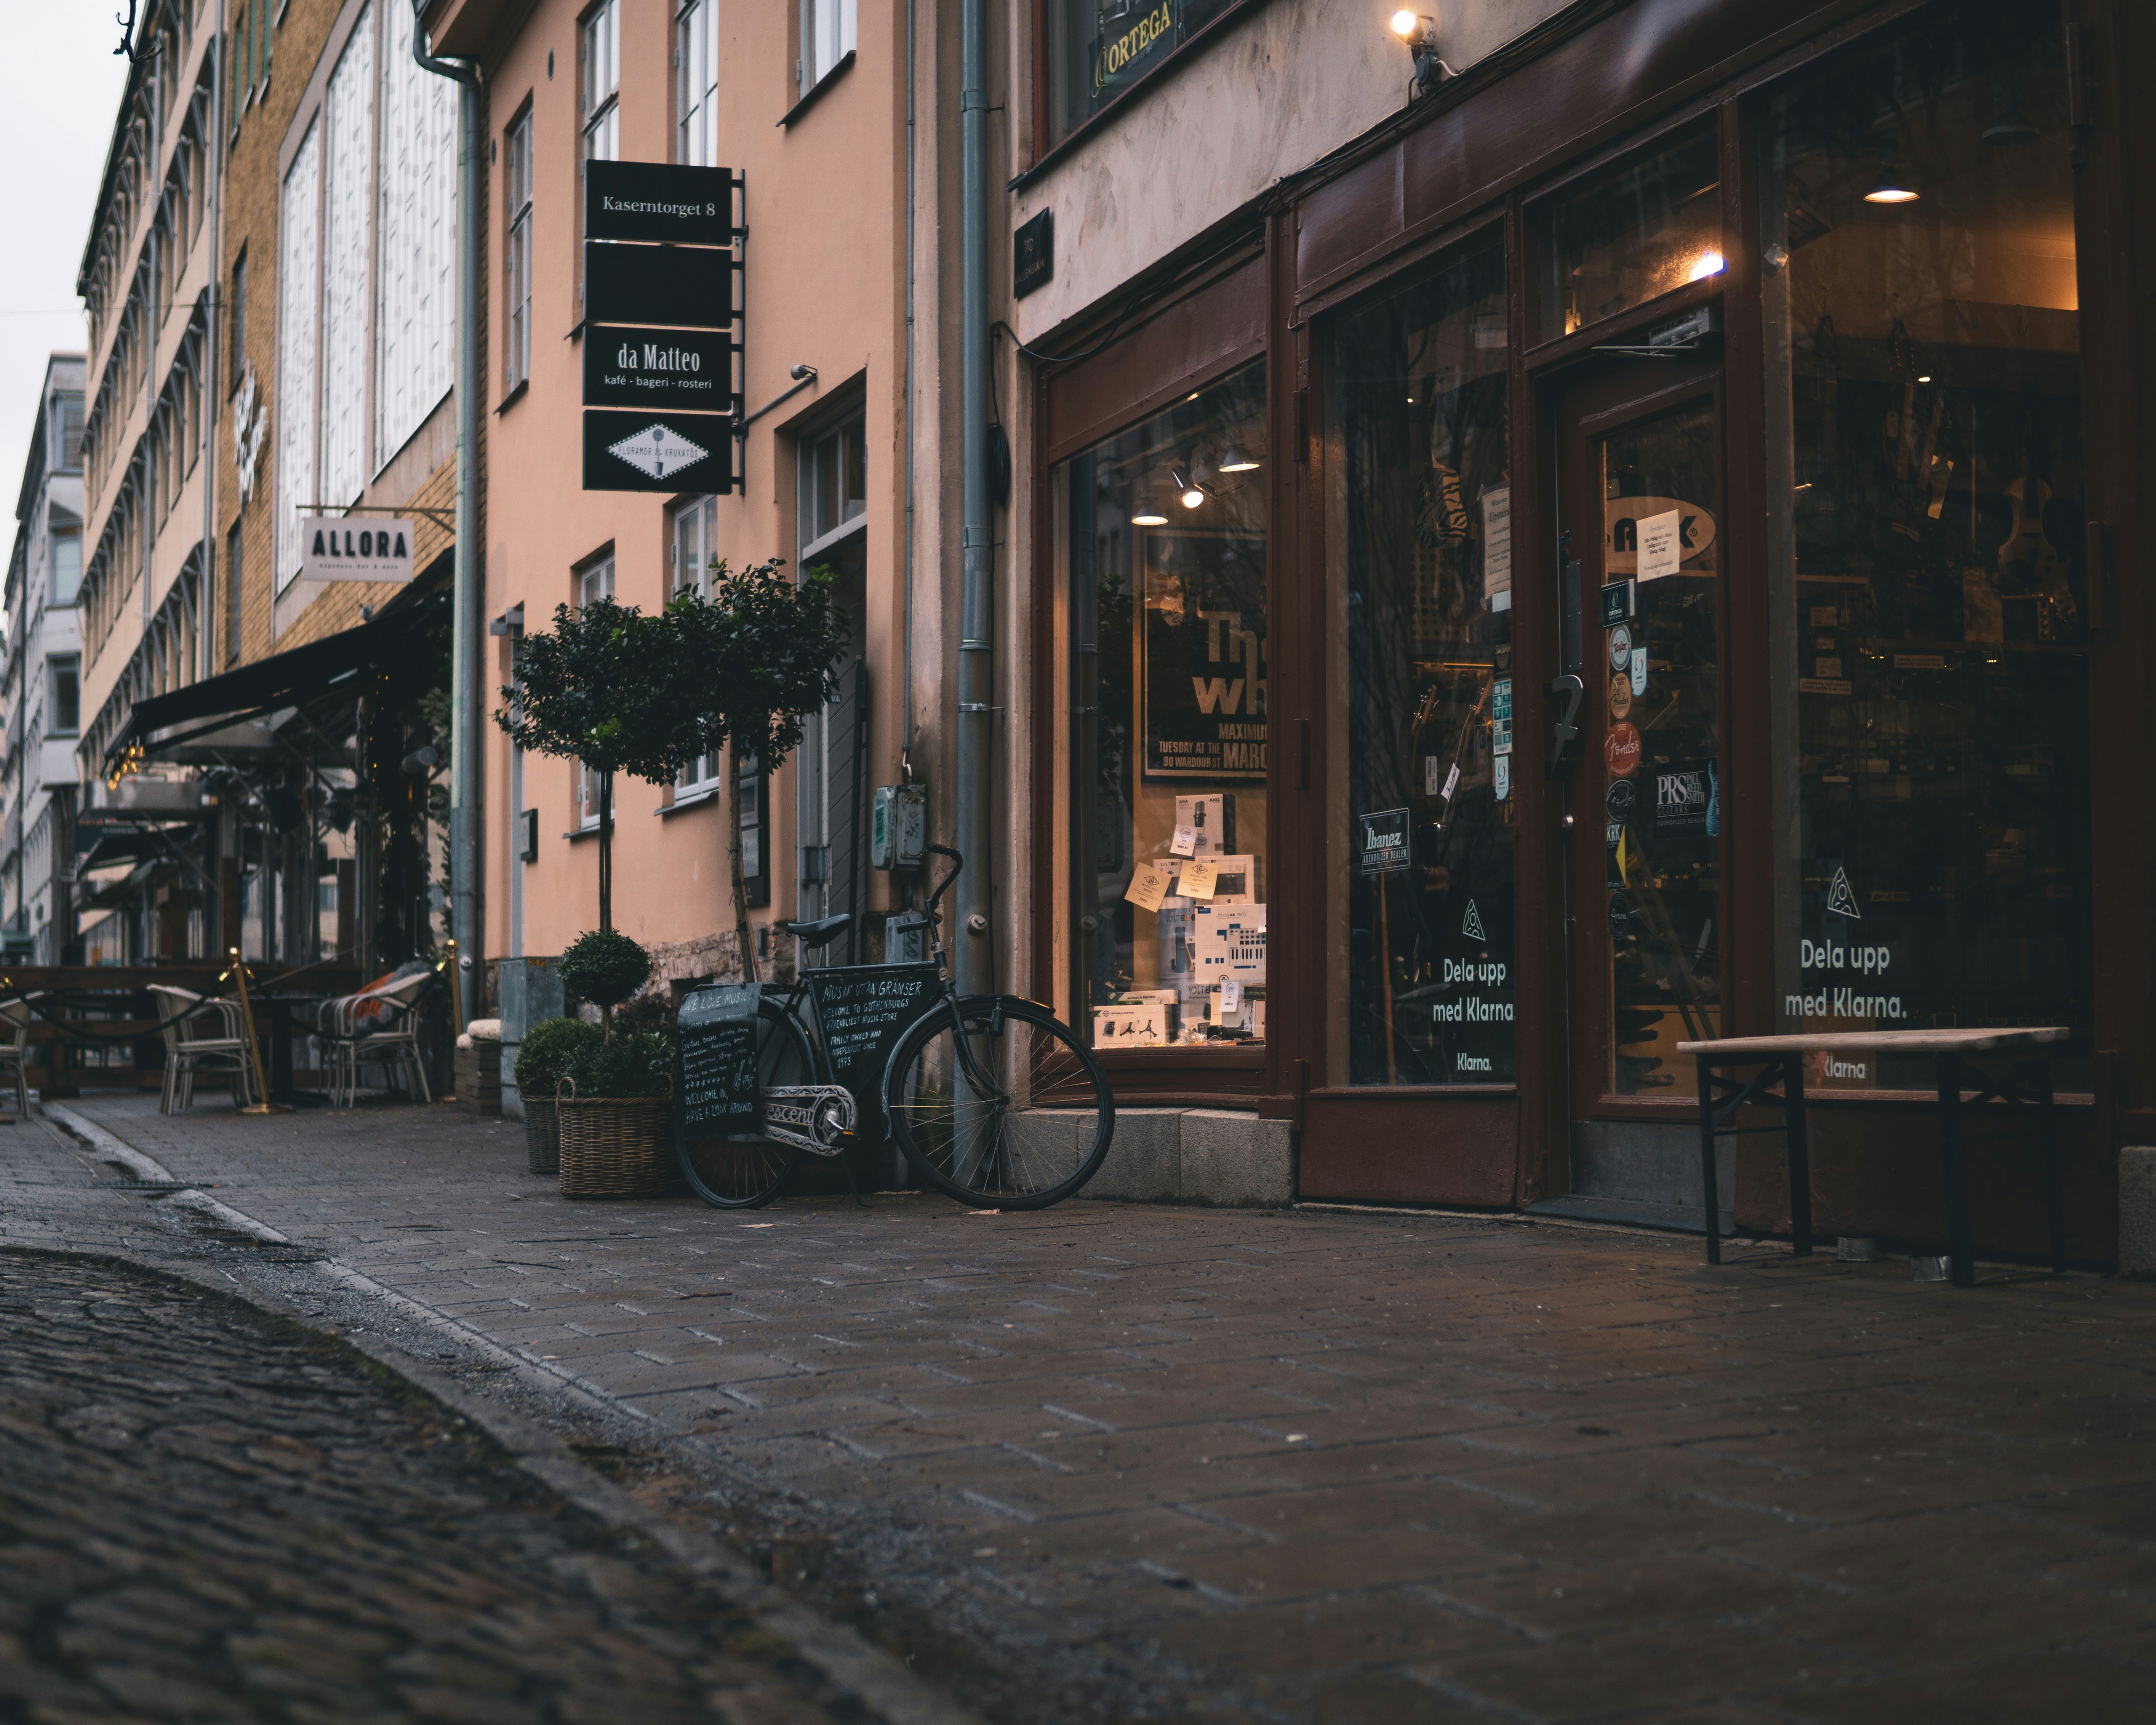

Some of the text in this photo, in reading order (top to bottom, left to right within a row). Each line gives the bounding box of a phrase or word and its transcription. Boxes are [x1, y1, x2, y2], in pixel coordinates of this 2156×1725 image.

[1109, 1, 1171, 73] ORTEGA
[603, 196, 715, 218] Kaserntorget 8
[618, 343, 700, 372] da Matteo
[605, 375, 712, 389] kafé bageri rosteri
[619, 446, 652, 456] FLORAMOR
[312, 529, 407, 558] ALLORA
[1197, 610, 1267, 663] Th
[1159, 741, 1221, 754] TUESDAY AT THE
[1605, 730, 1640, 762] Fender
[1164, 756, 1221, 768] 90 WARDOUR ST
[1686, 773, 1700, 784] PAUL
[1687, 783, 1702, 793] REED
[1656, 775, 1687, 805] PRS
[1687, 791, 1705, 803] SMITH
[1657, 805, 1688, 816] GUITARS
[1366, 827, 1402, 850] Ibanez
[1607, 824, 1620, 842] KRK
[1363, 849, 1407, 864] AUTHORIZED DEALER
[1801, 939, 1891, 974] Dela upp
[1444, 958, 1506, 986] Dela upp
[685, 988, 753, 1011] WE LOVE MUSIC!
[822, 978, 922, 1003] MUSIK UTAN GRÄNSER
[823, 999, 909, 1019] WELCOME TO GOTHENBURGS
[1433, 997, 1462, 1021] med
[1785, 986, 1907, 1019] med Klarna.
[827, 1012, 898, 1032] FRIENDLIEST MUSIC STORE
[831, 1029, 881, 1046] FAMILY OWNED AND
[832, 1041, 876, 1057] INDEPENDENT SINCE
[837, 1056, 851, 1069] 1973
[1457, 1053, 1492, 1071] Klarna.
[685, 1087, 729, 1106] WELCOME IN,
[686, 1102, 753, 1124] HAVE A LOOK AROUND
